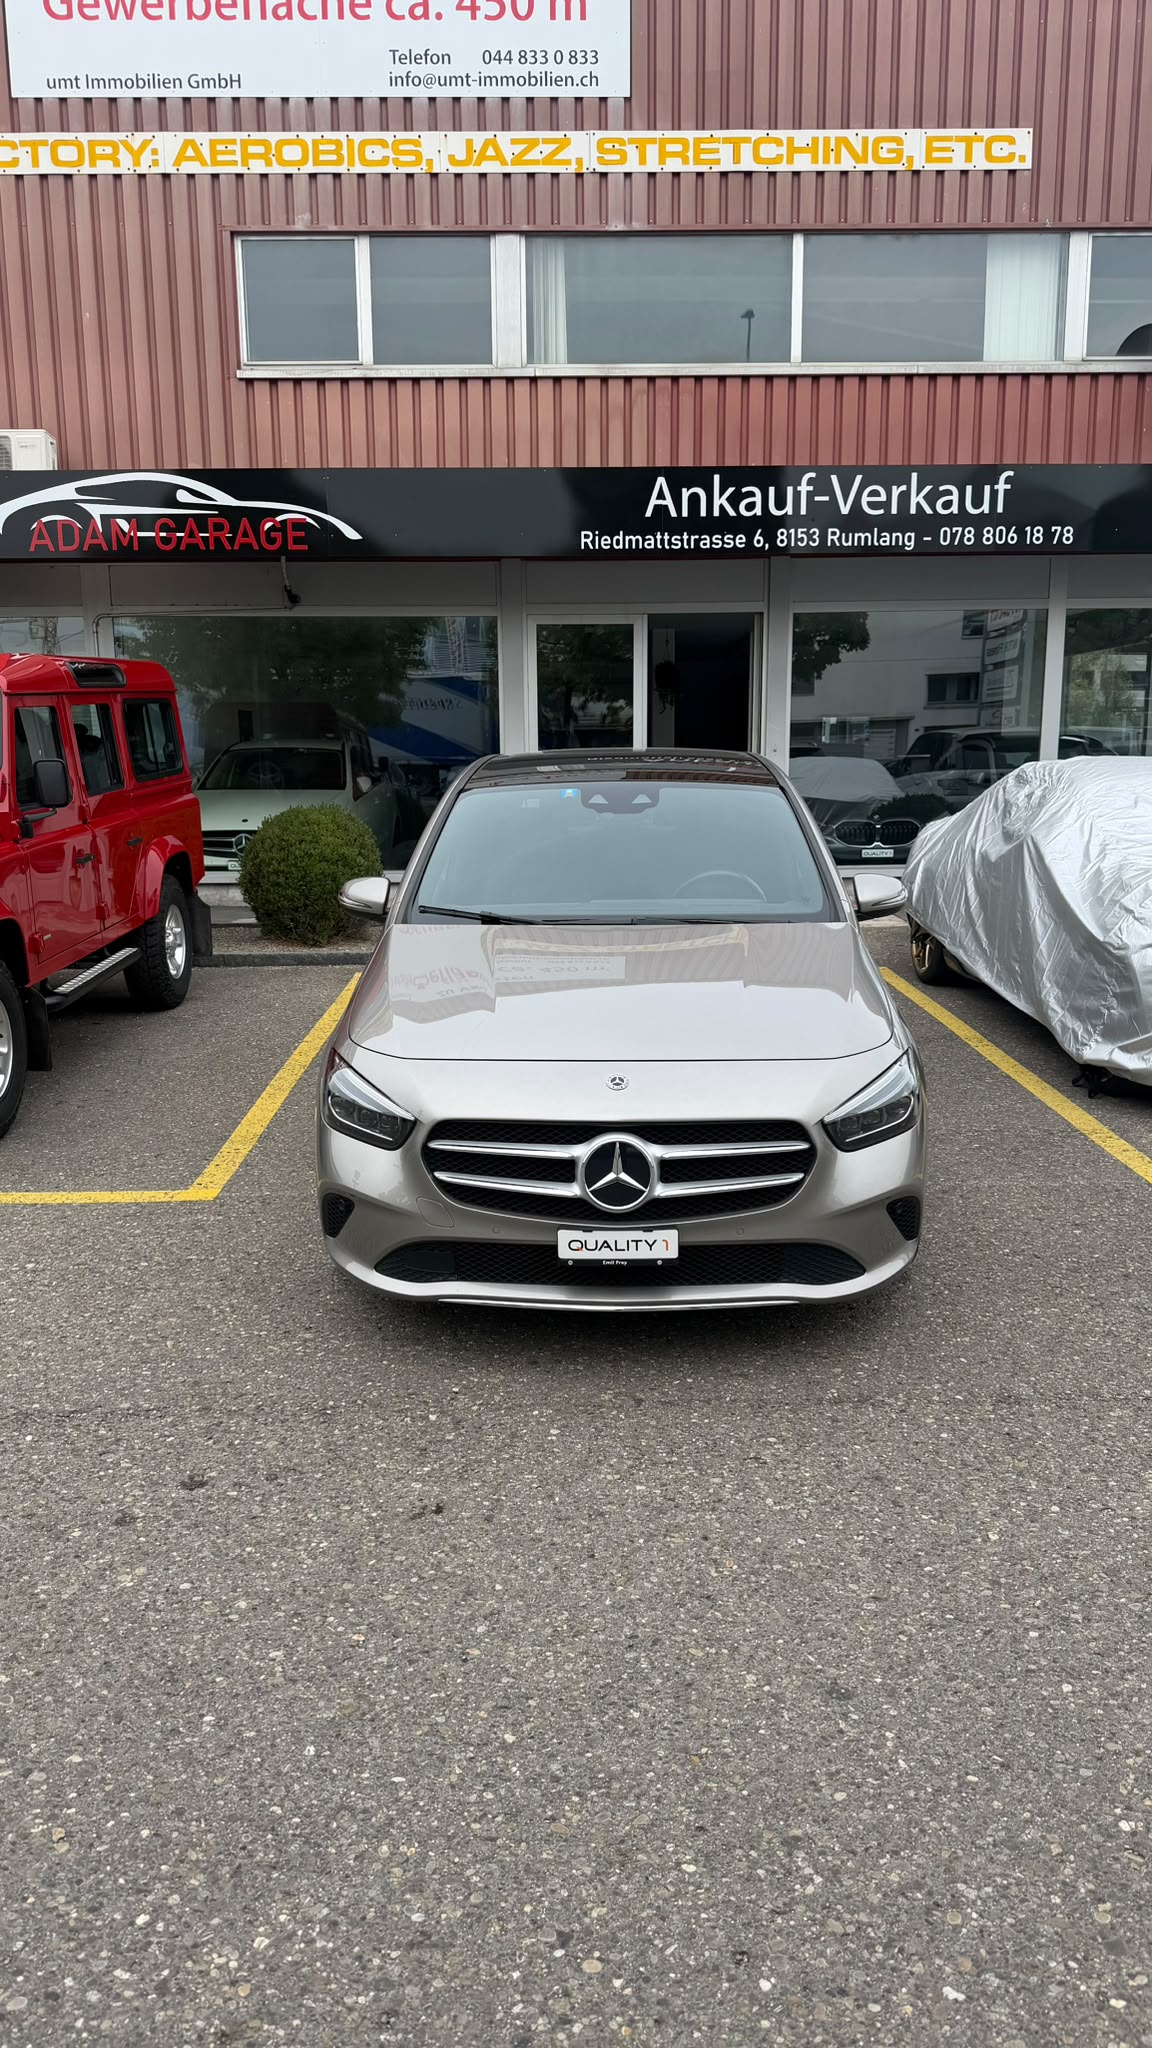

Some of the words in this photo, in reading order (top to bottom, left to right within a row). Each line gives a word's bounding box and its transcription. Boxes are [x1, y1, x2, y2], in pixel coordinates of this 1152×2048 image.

[385, 0, 443, 21] ca.
[388, 48, 451, 65] Telefon
[482, 49, 513, 65] 044
[518, 49, 548, 65] 833
[553, 49, 564, 65] 0
[568, 49, 598, 65] 833
[46, 75, 80, 90] umt
[86, 73, 183, 90] Immobilien
[187, 72, 241, 90] GmbH
[389, 70, 599, 90] info@umt-immobilien.ch
[172, 138, 435, 174] AEROBICS,
[447, 137, 584, 174] JAZZ,
[596, 135, 915, 171] STRETCHING,
[924, 135, 1027, 165] ETC.
[644, 471, 1015, 518] Ankauf-Verkauf
[29, 519, 138, 552] ADAM
[154, 518, 309, 552] GARAGE
[580, 530, 746, 550] Riedmattstrasse
[753, 529, 769, 551] 6,
[776, 528, 820, 547] 8153
[827, 527, 915, 551] Rumlang
[939, 527, 975, 546] 078
[982, 526, 1018, 545] 806
[1024, 526, 1044, 545] 18
[1051, 526, 1074, 545] 78
[567, 1239, 658, 1252] QUALITY
[662, 1239, 670, 1252] 1
